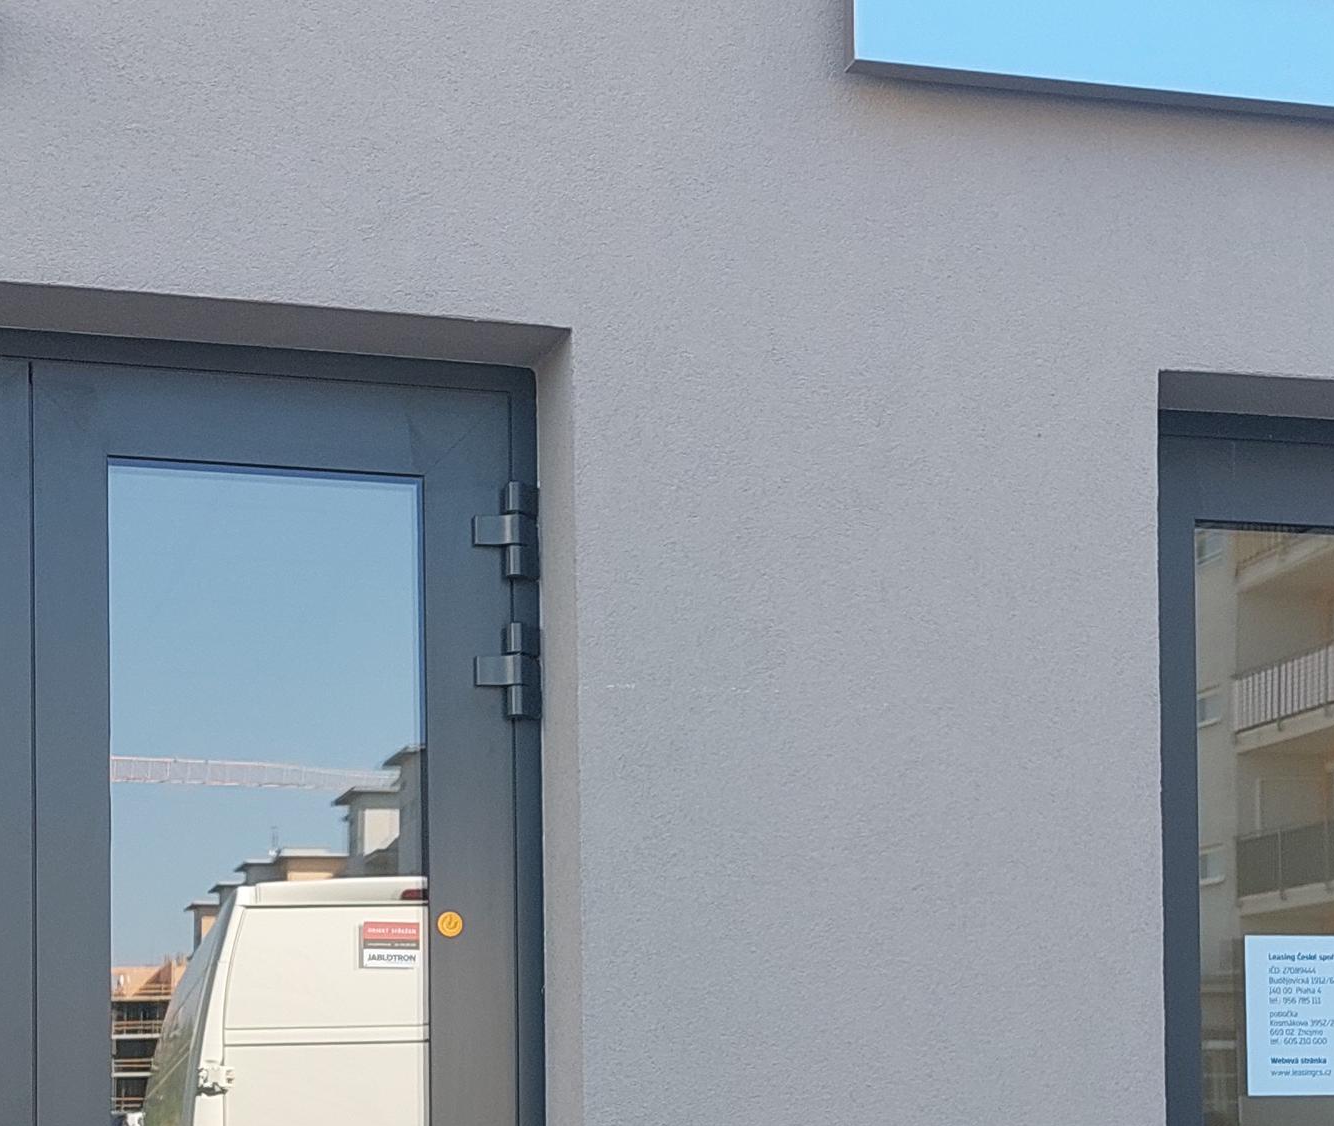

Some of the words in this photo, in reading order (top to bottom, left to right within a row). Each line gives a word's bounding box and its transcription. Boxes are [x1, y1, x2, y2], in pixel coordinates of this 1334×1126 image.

[368, 953, 418, 962] JABLOTRON
[1268, 952, 1296, 962] Leasing
[1296, 952, 1317, 961] České
[1270, 1056, 1299, 1064] Webová
[1300, 1056, 1327, 1064] stránka
